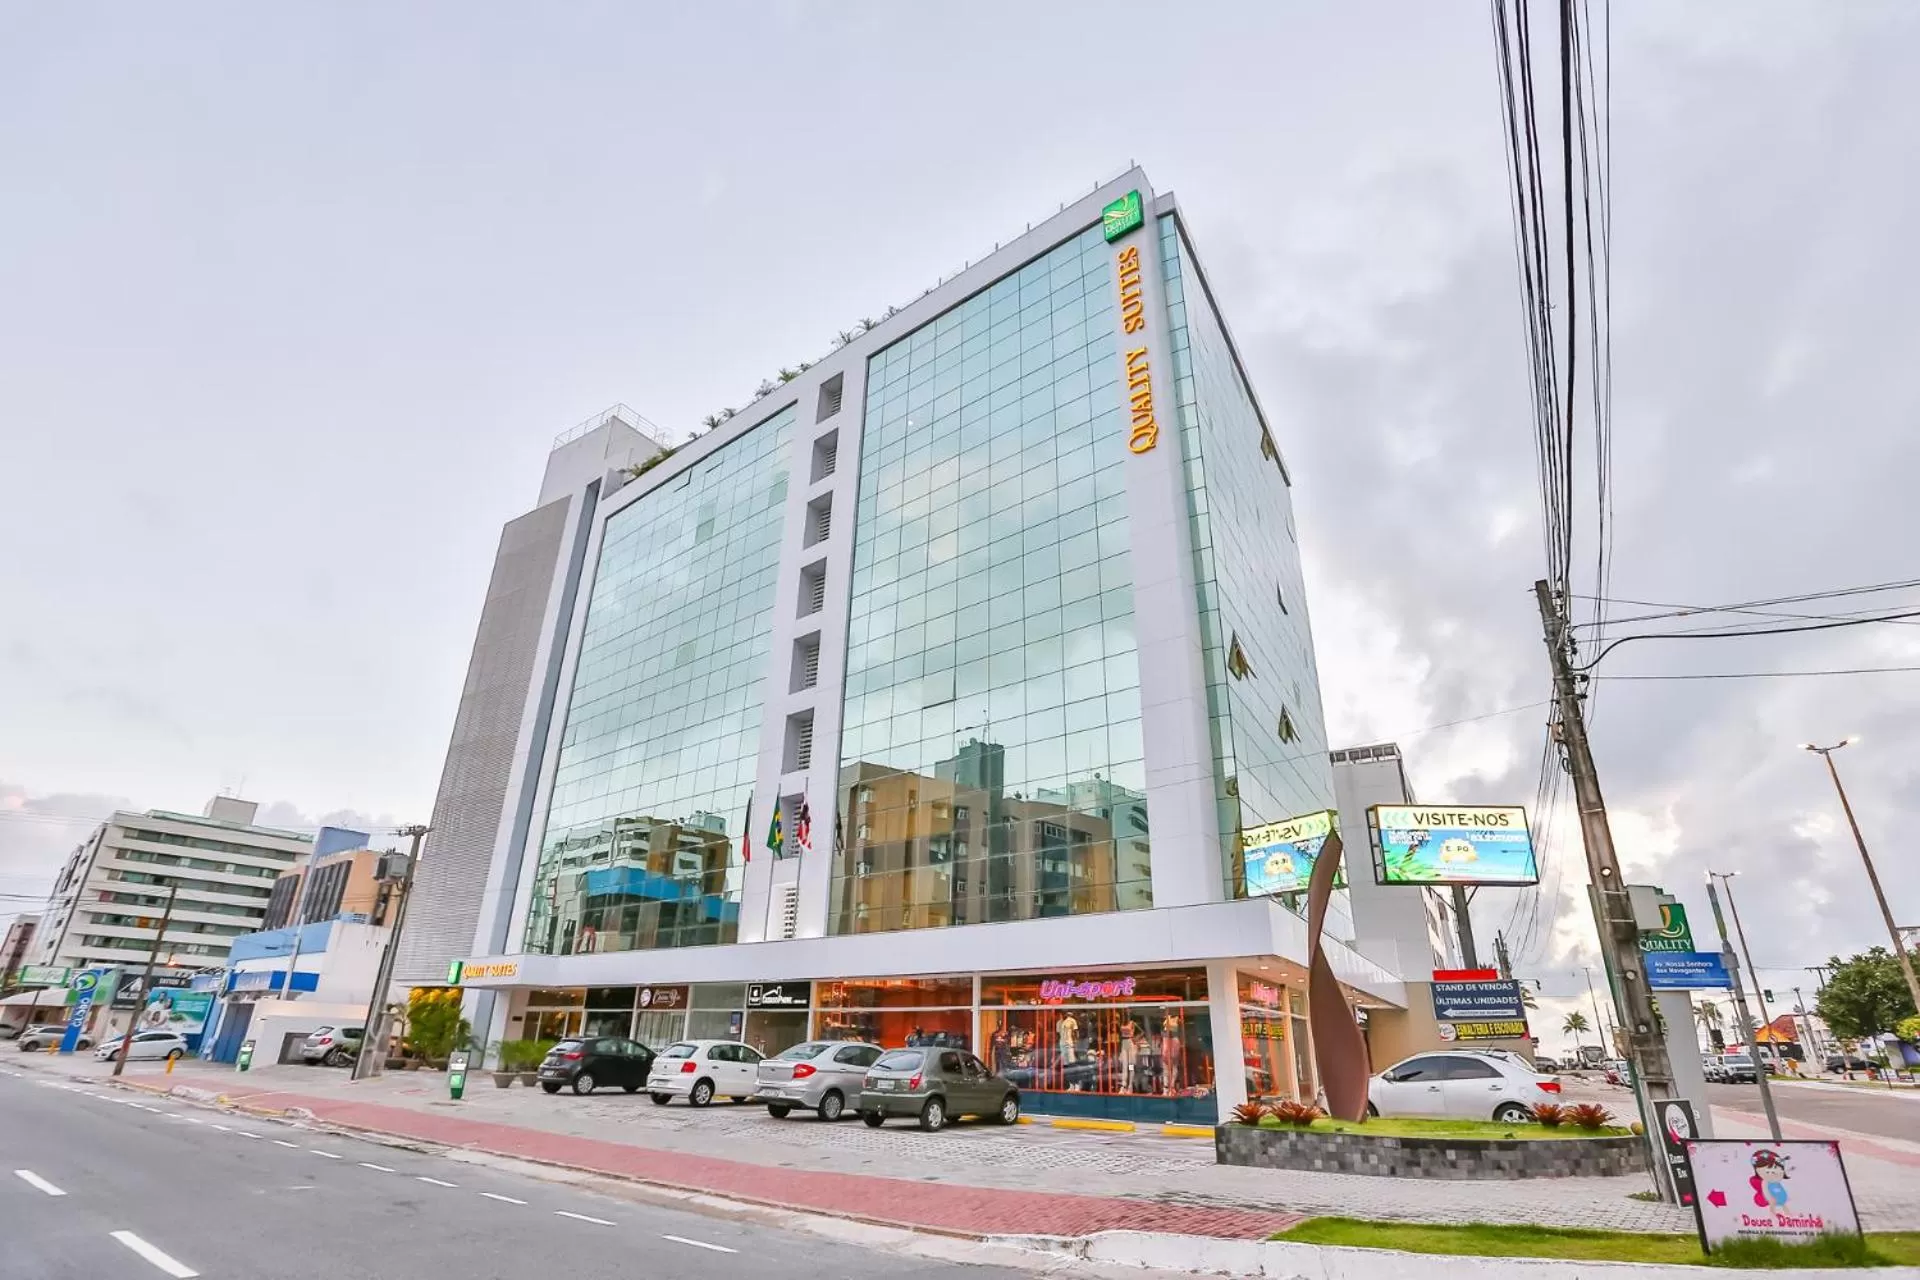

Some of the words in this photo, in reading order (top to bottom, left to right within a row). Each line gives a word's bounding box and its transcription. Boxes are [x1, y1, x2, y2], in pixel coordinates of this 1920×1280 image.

[1117, 244, 1144, 335] SUITES
[1127, 345, 1160, 455] QUALITY
[1412, 812, 1509, 827] VISITE-NOS
[1638, 939, 1691, 952] QUALITY
[1040, 976, 1136, 1000] Uni-sport
[1436, 983, 1463, 991] STAND
[1465, 983, 1477, 991] DE
[1478, 982, 1514, 991] VENDAS
[1474, 996, 1519, 1005] UNIDADES
[1742, 1214, 1773, 1227] Douce
